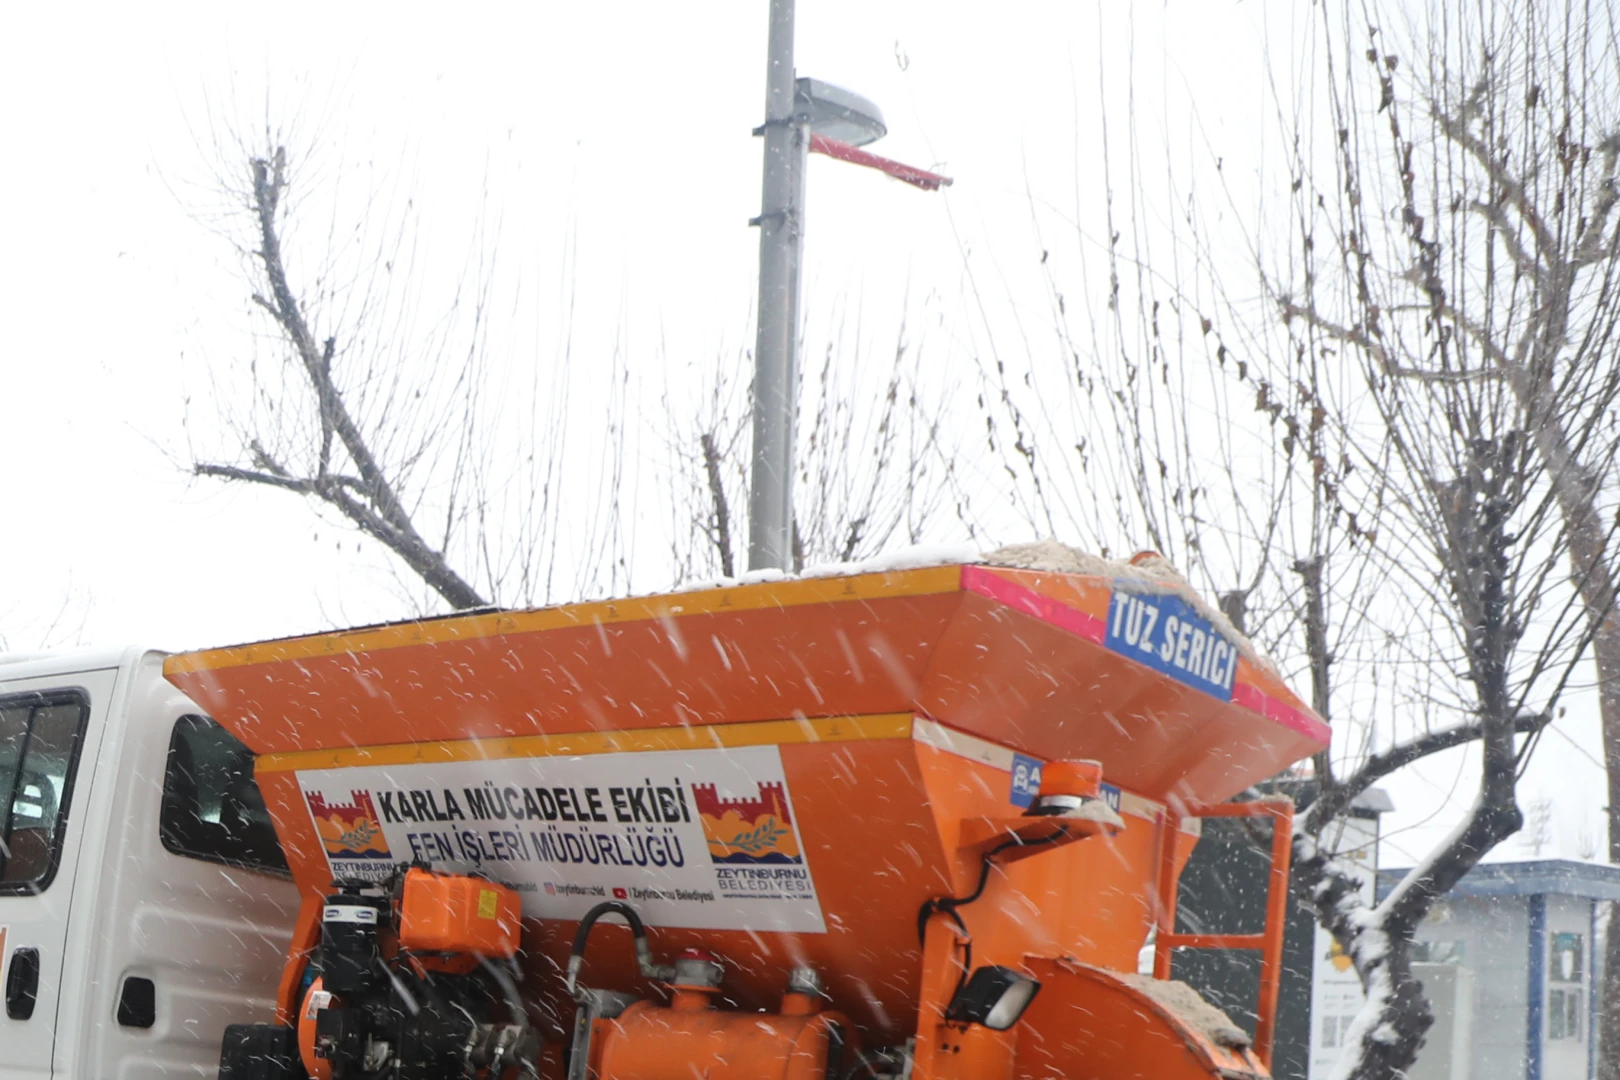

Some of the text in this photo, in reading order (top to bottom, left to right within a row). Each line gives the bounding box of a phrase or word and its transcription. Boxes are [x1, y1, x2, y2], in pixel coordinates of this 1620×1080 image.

[1112, 591, 1159, 653] TUZ
[377, 777, 691, 823] KARLA MÜCADELE EKİBİ
[407, 824, 685, 868] FEN İŞLERİ MÜDÜRLÜĞÜ
